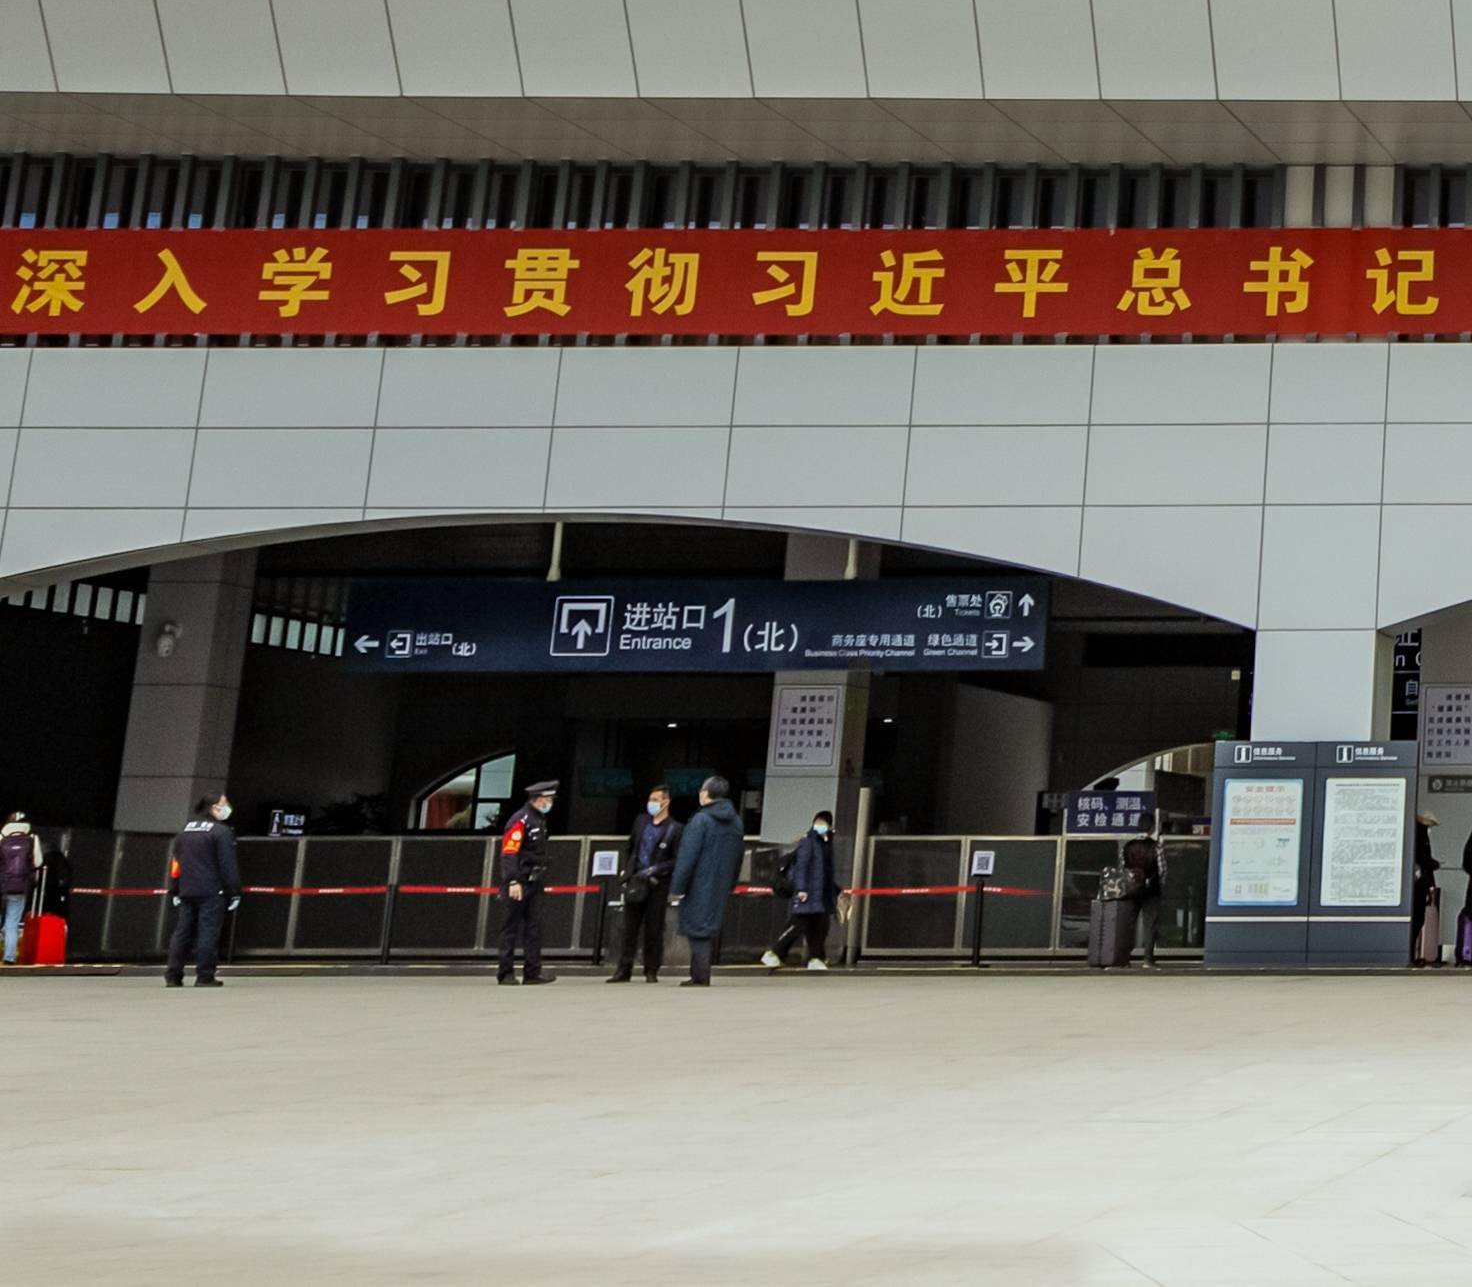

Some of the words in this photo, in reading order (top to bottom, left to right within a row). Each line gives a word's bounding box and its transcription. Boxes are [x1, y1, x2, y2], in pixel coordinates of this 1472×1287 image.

[623, 603, 705, 630] 进站口
[416, 634, 454, 645] 出站口
[620, 634, 691, 649] Entrance
[832, 634, 915, 646] 商务座专用通道
[925, 634, 977, 650] 绿色通道
